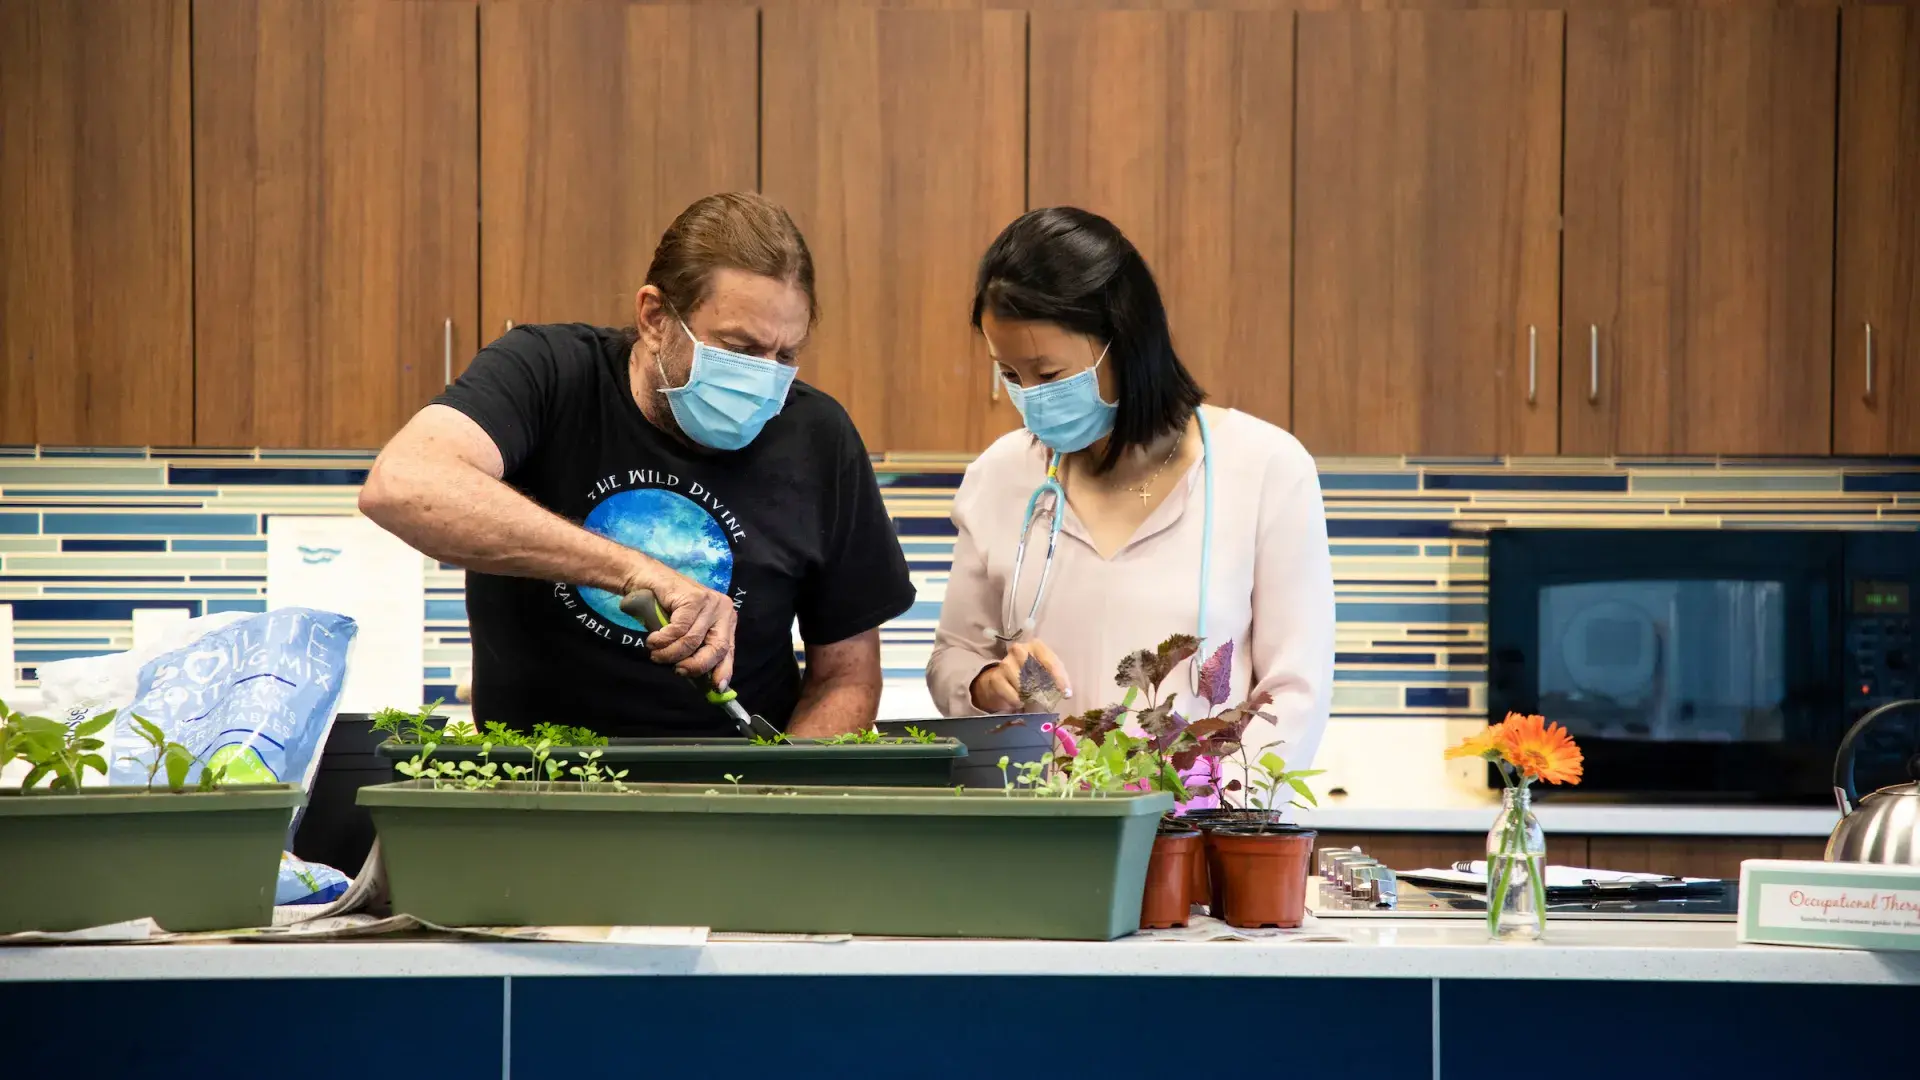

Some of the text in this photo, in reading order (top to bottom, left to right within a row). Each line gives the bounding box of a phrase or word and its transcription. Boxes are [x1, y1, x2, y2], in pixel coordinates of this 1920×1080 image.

[587, 469, 747, 544] THE WILD DIVINE
[575, 613, 612, 640] ABEL
[1788, 890, 1878, 915] Occupational
